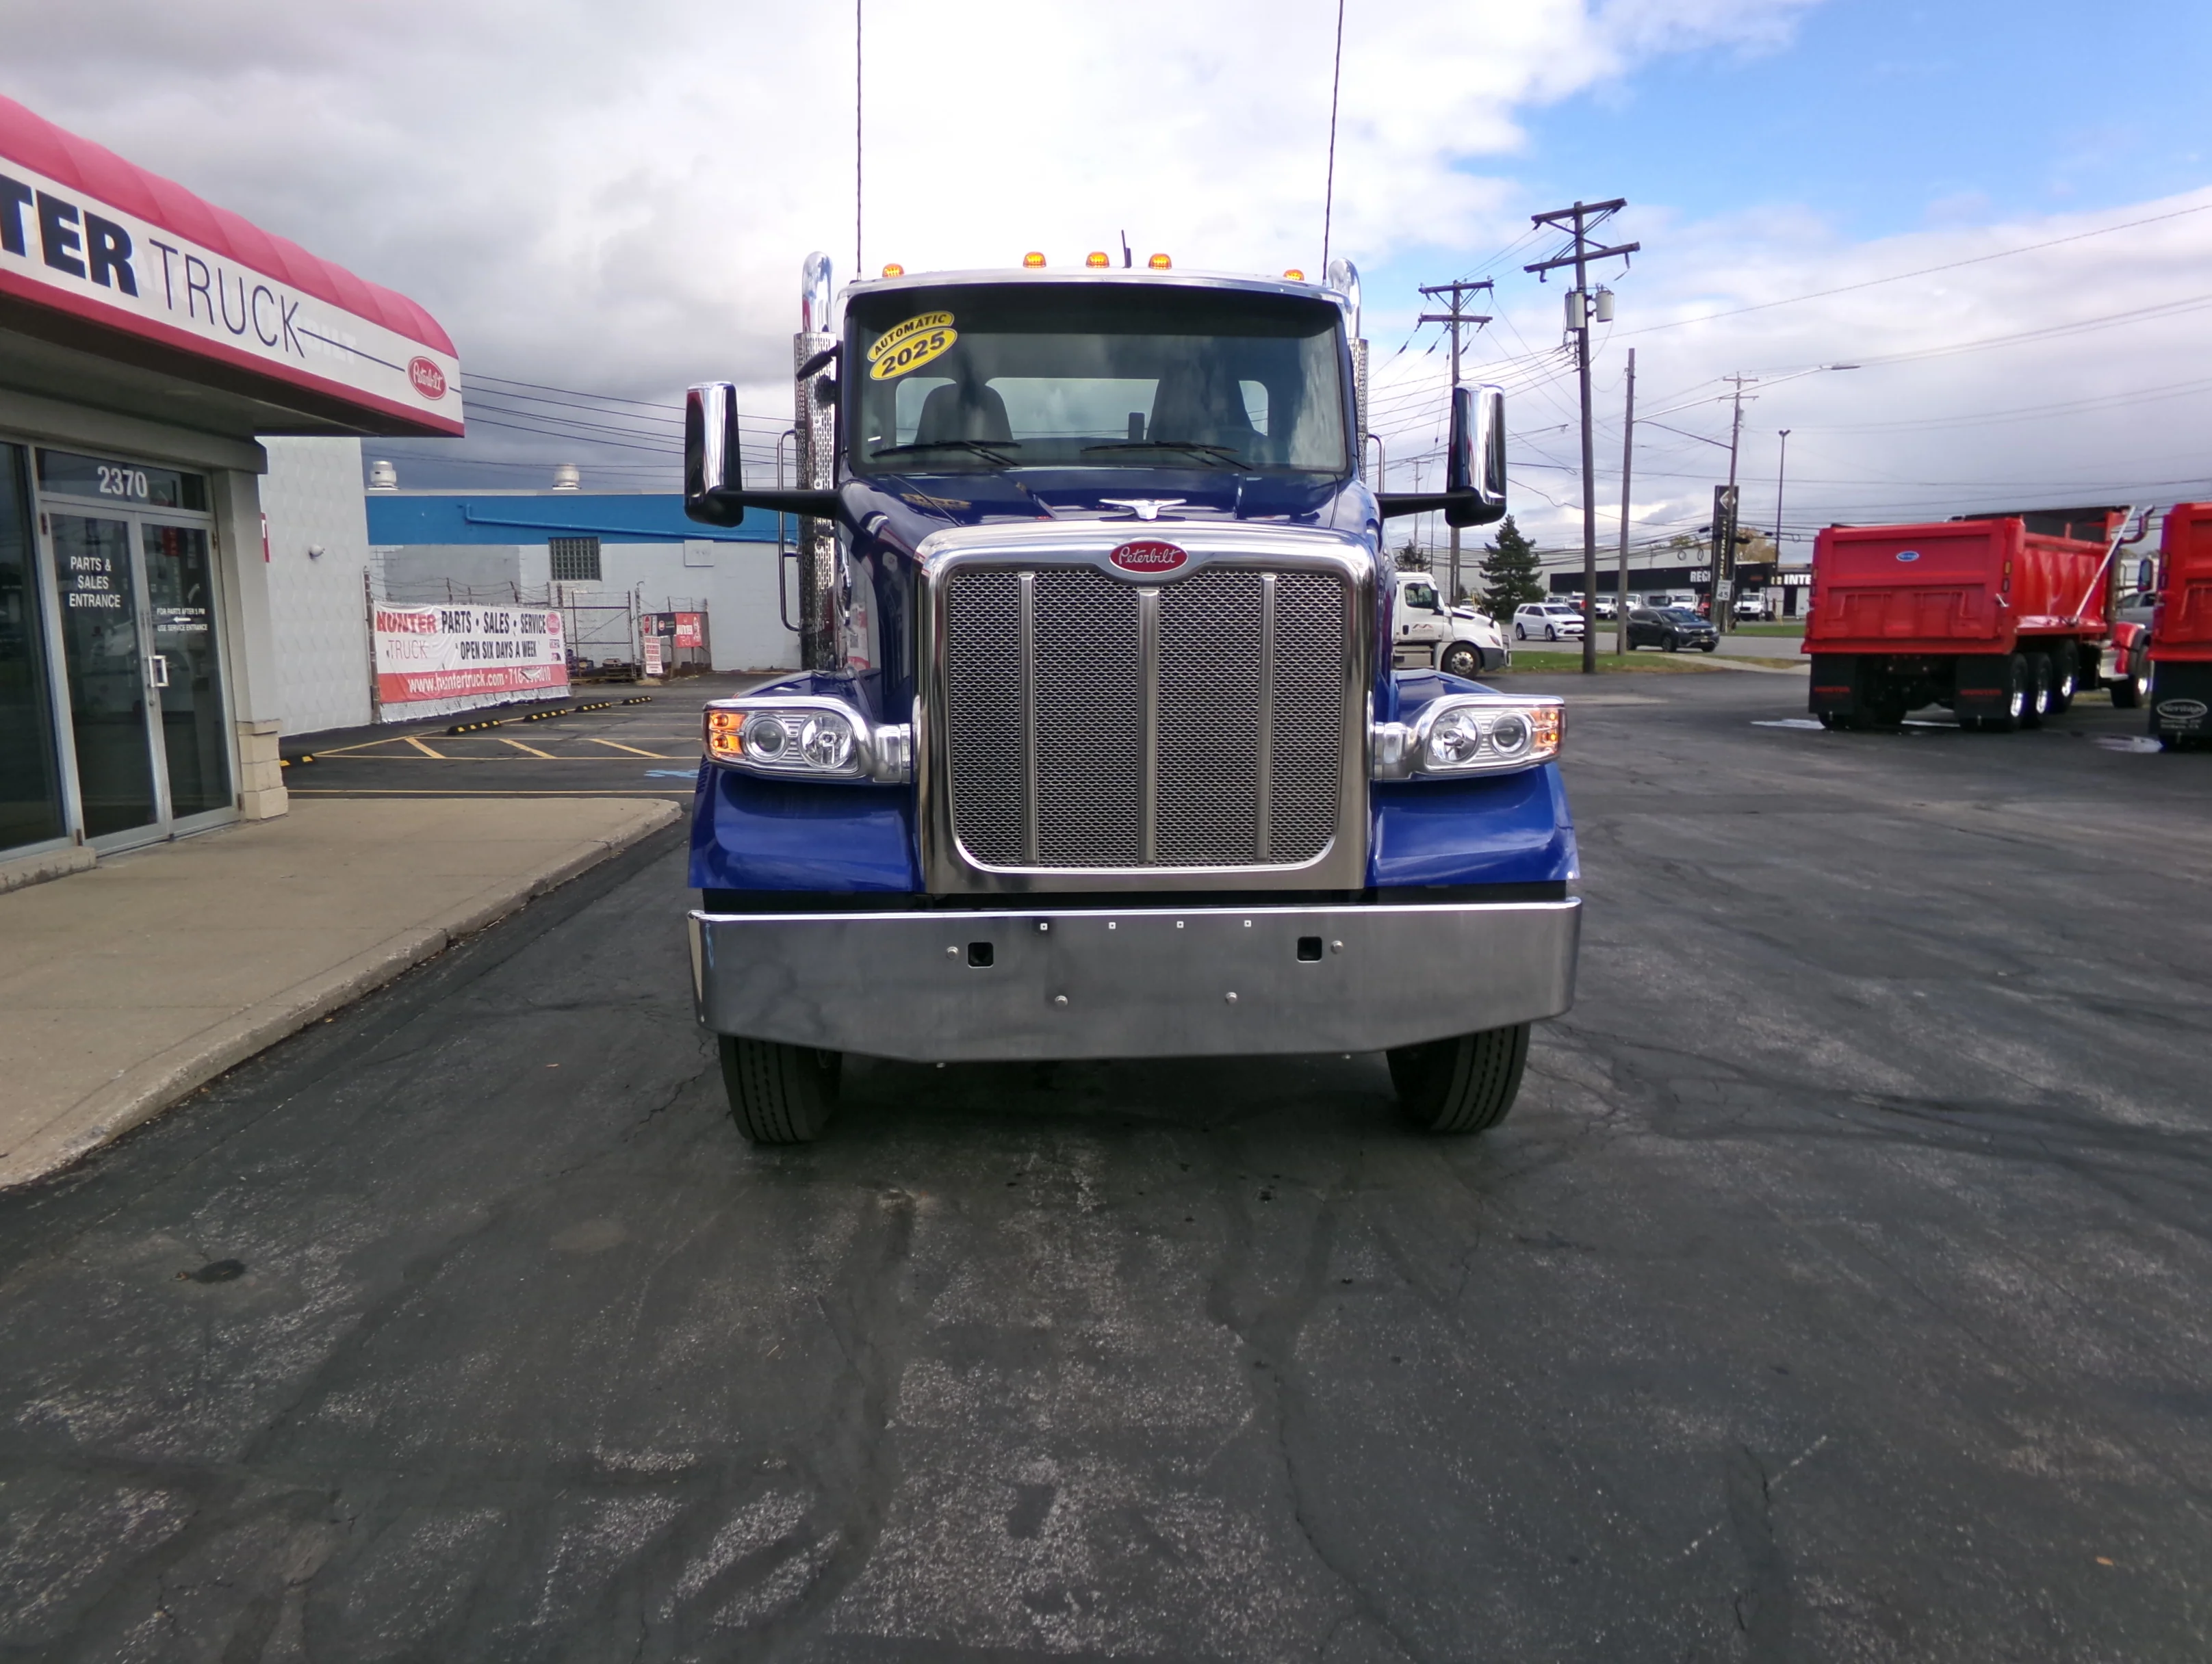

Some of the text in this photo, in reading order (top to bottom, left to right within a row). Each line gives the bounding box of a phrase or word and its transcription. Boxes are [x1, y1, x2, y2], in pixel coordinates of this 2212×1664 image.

[148, 237, 305, 359] TRUCK
[875, 313, 947, 356] AUTOMATIC
[881, 330, 946, 378] 2025
[97, 465, 148, 498] 2370
[70, 556, 112, 572] PARTS &
[1118, 546, 1181, 565] Peterbilt
[77, 574, 110, 590] SALES
[69, 593, 121, 608] ENTRANCE
[376, 610, 437, 634] HUNTER
[441, 610, 472, 634] PARTS
[483, 611, 510, 634] SALES
[520, 613, 546, 634] SERVICE
[388, 640, 428, 660] TRUCK
[460, 641, 480, 660] OPEN
[482, 641, 494, 660] SIX
[496, 641, 513, 659] DAYS
[515, 642, 521, 658] A
[522, 640, 538, 658] WEEK
[407, 669, 504, 693] www.huntertruck.com
